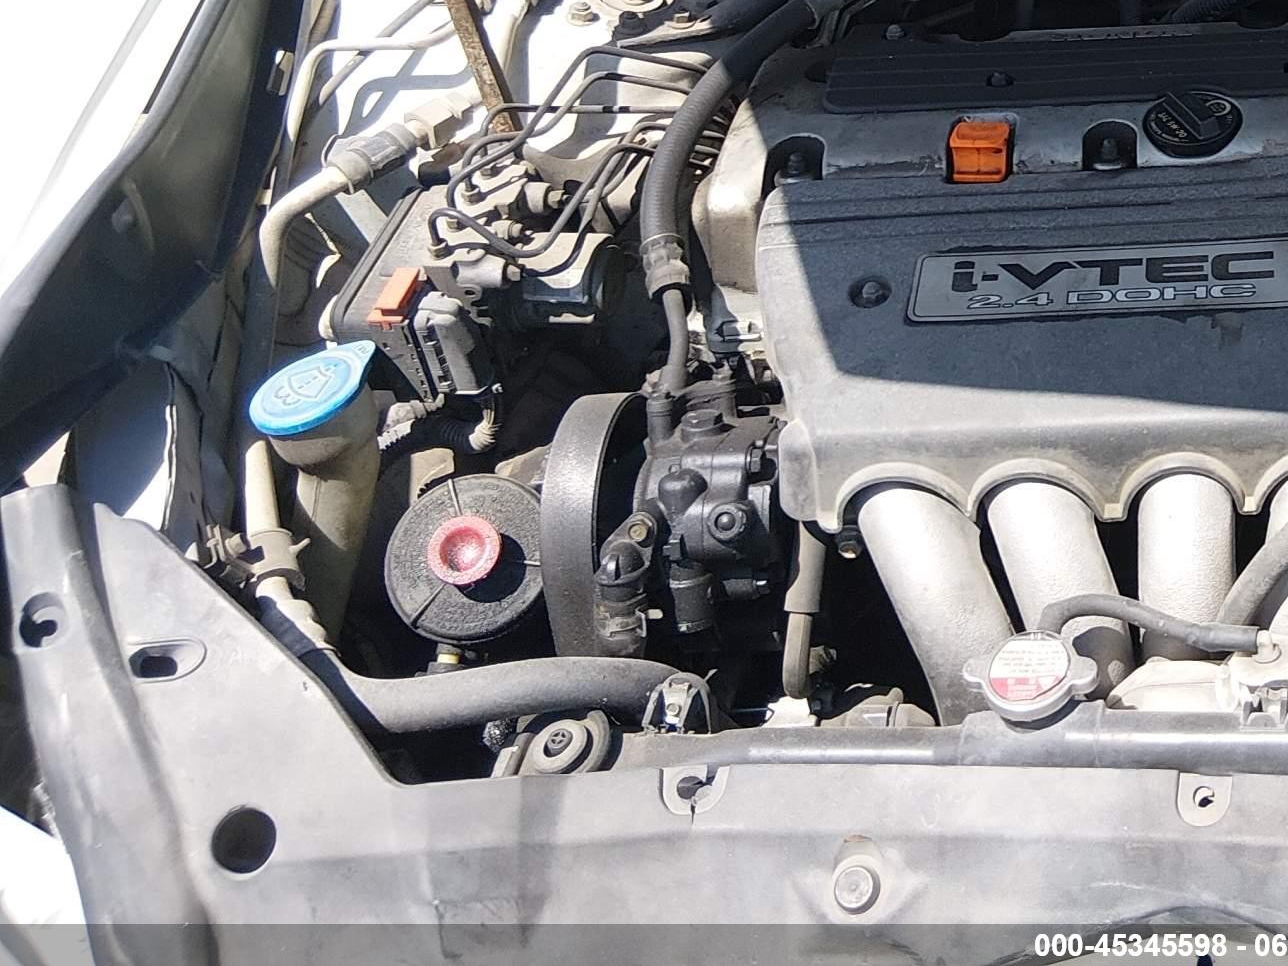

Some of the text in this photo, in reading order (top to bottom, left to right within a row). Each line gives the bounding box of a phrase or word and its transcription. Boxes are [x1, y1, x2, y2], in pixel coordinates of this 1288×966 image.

[951, 250, 1275, 293] i-VTEC
[967, 283, 1257, 310] 2.4 DOHC
